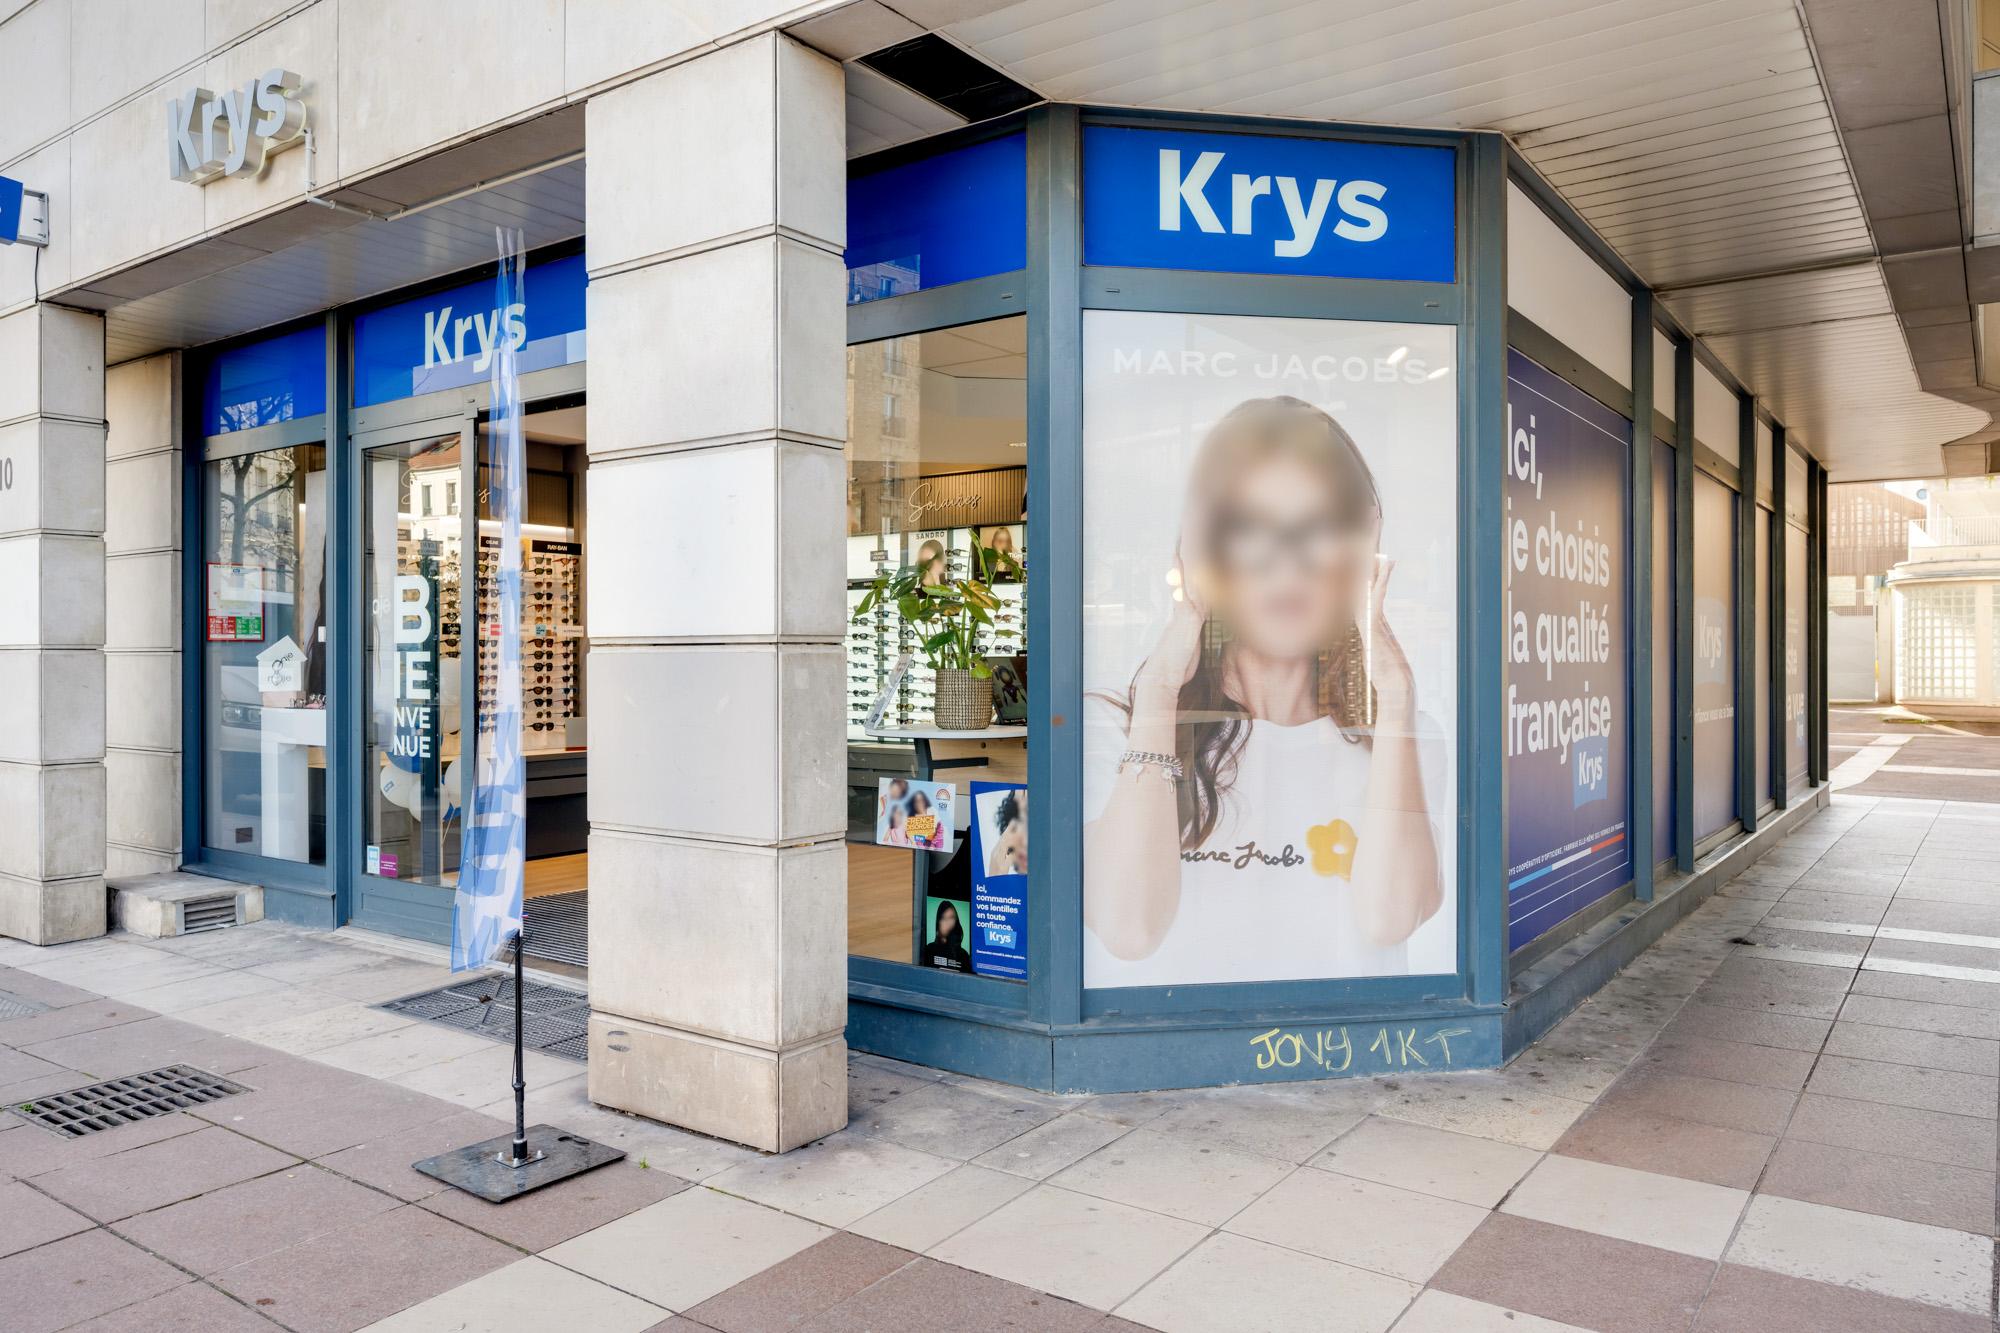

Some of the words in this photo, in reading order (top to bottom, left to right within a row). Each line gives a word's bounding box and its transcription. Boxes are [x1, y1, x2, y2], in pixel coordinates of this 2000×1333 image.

[167, 67, 303, 184] Krys
[1159, 148, 1389, 258] Krys
[425, 303, 527, 373] Krys
[1112, 348, 1238, 378] MARC
[1254, 353, 1431, 385] JACOBS
[1507, 402, 1543, 500] Ici,
[916, 531, 945, 540] SANDRO
[1508, 496, 1529, 588] je
[1535, 510, 1610, 588] choisis
[1508, 590, 1530, 664] la
[1535, 600, 1610, 681] qualité
[1508, 680, 1612, 765] française
[1578, 751, 1603, 791] Krys
[1234, 841, 1305, 870] Jacobs
[976, 884, 987, 893] Ici,
[976, 894, 1022, 905] commandez
[976, 903, 989, 911] vos
[990, 903, 1018, 914] lentilles
[976, 921, 1014, 931] confiance.
[986, 913, 1006, 921] toute
[989, 931, 1011, 944] Krys
